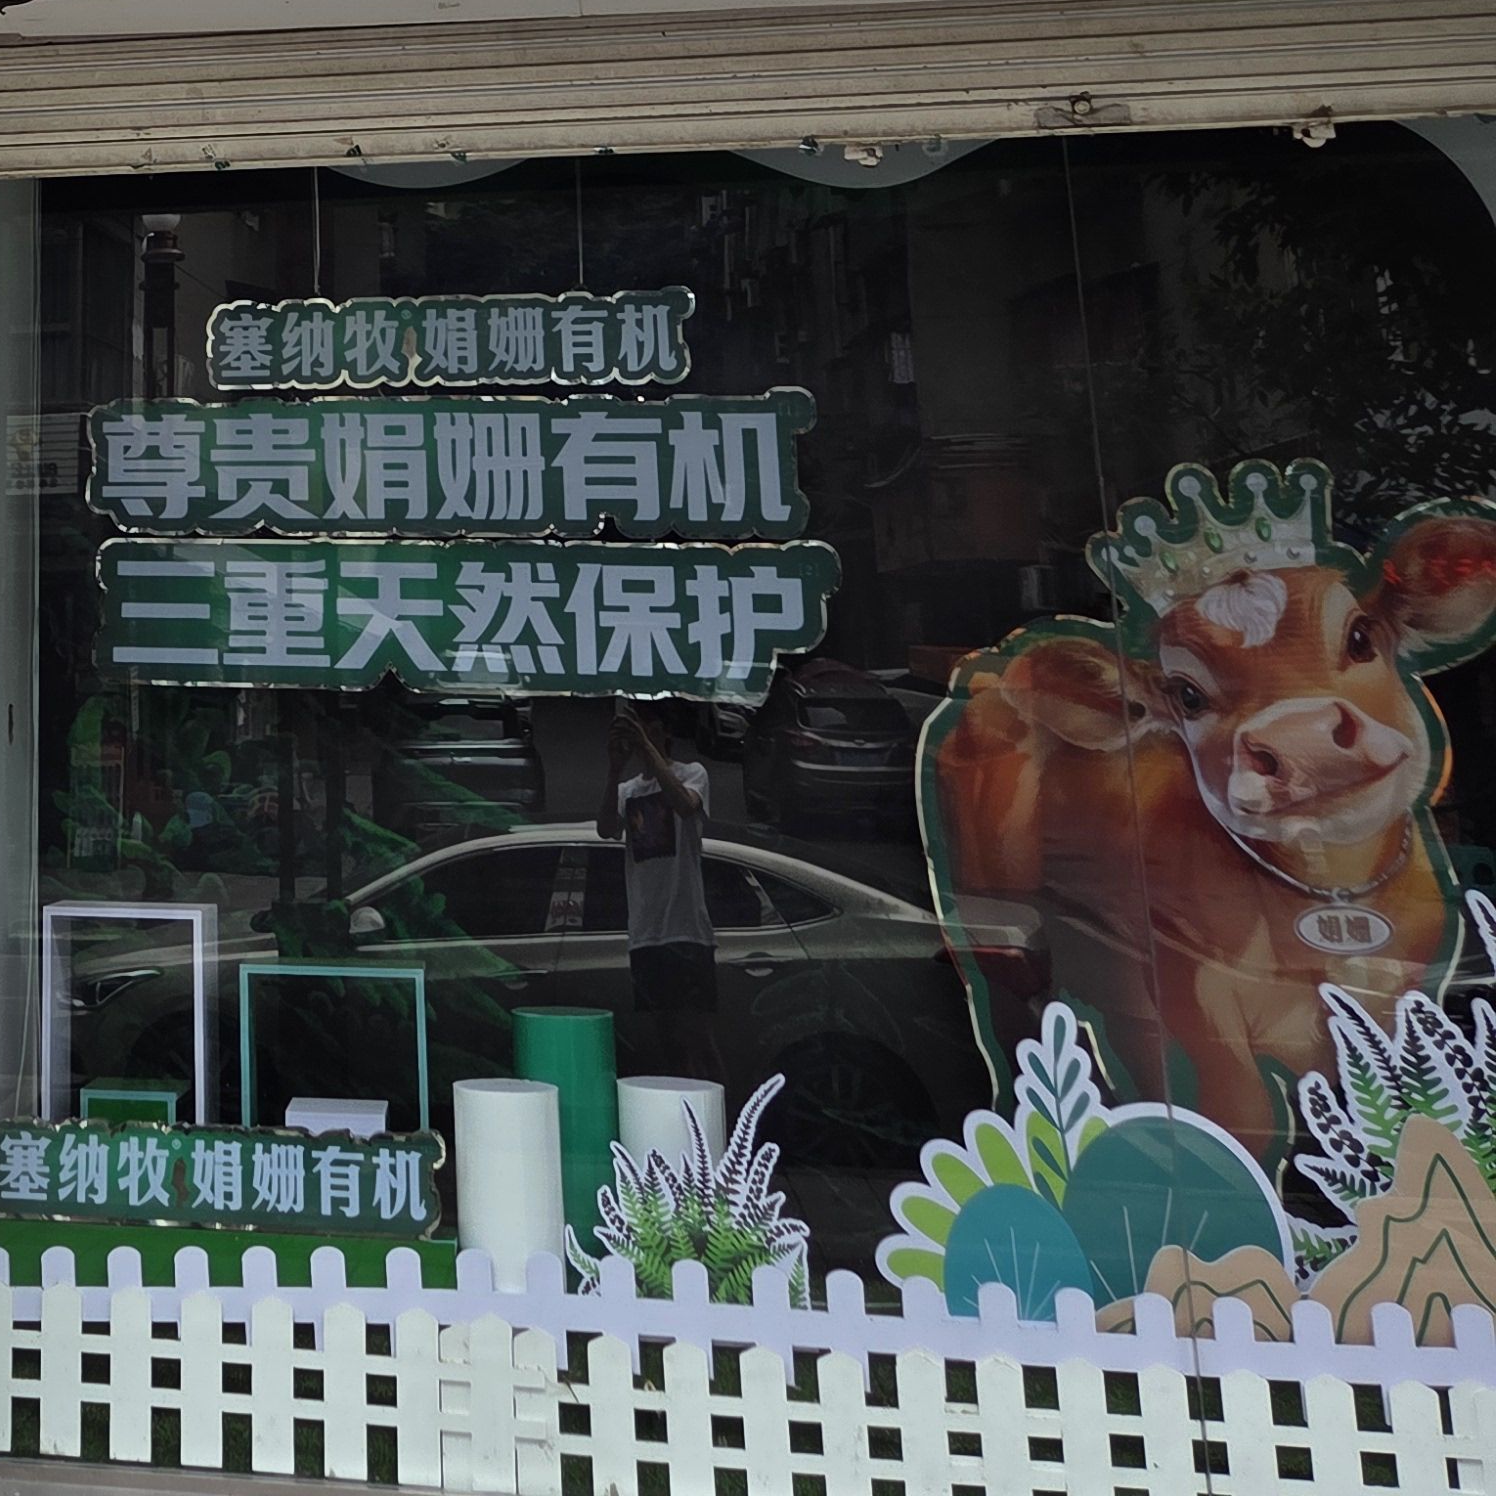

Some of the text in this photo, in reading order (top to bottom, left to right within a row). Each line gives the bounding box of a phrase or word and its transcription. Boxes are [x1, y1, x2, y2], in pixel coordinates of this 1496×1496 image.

[102, 410, 791, 522] 尊贵娟姗有机
[112, 558, 804, 679] 三重天然保护
